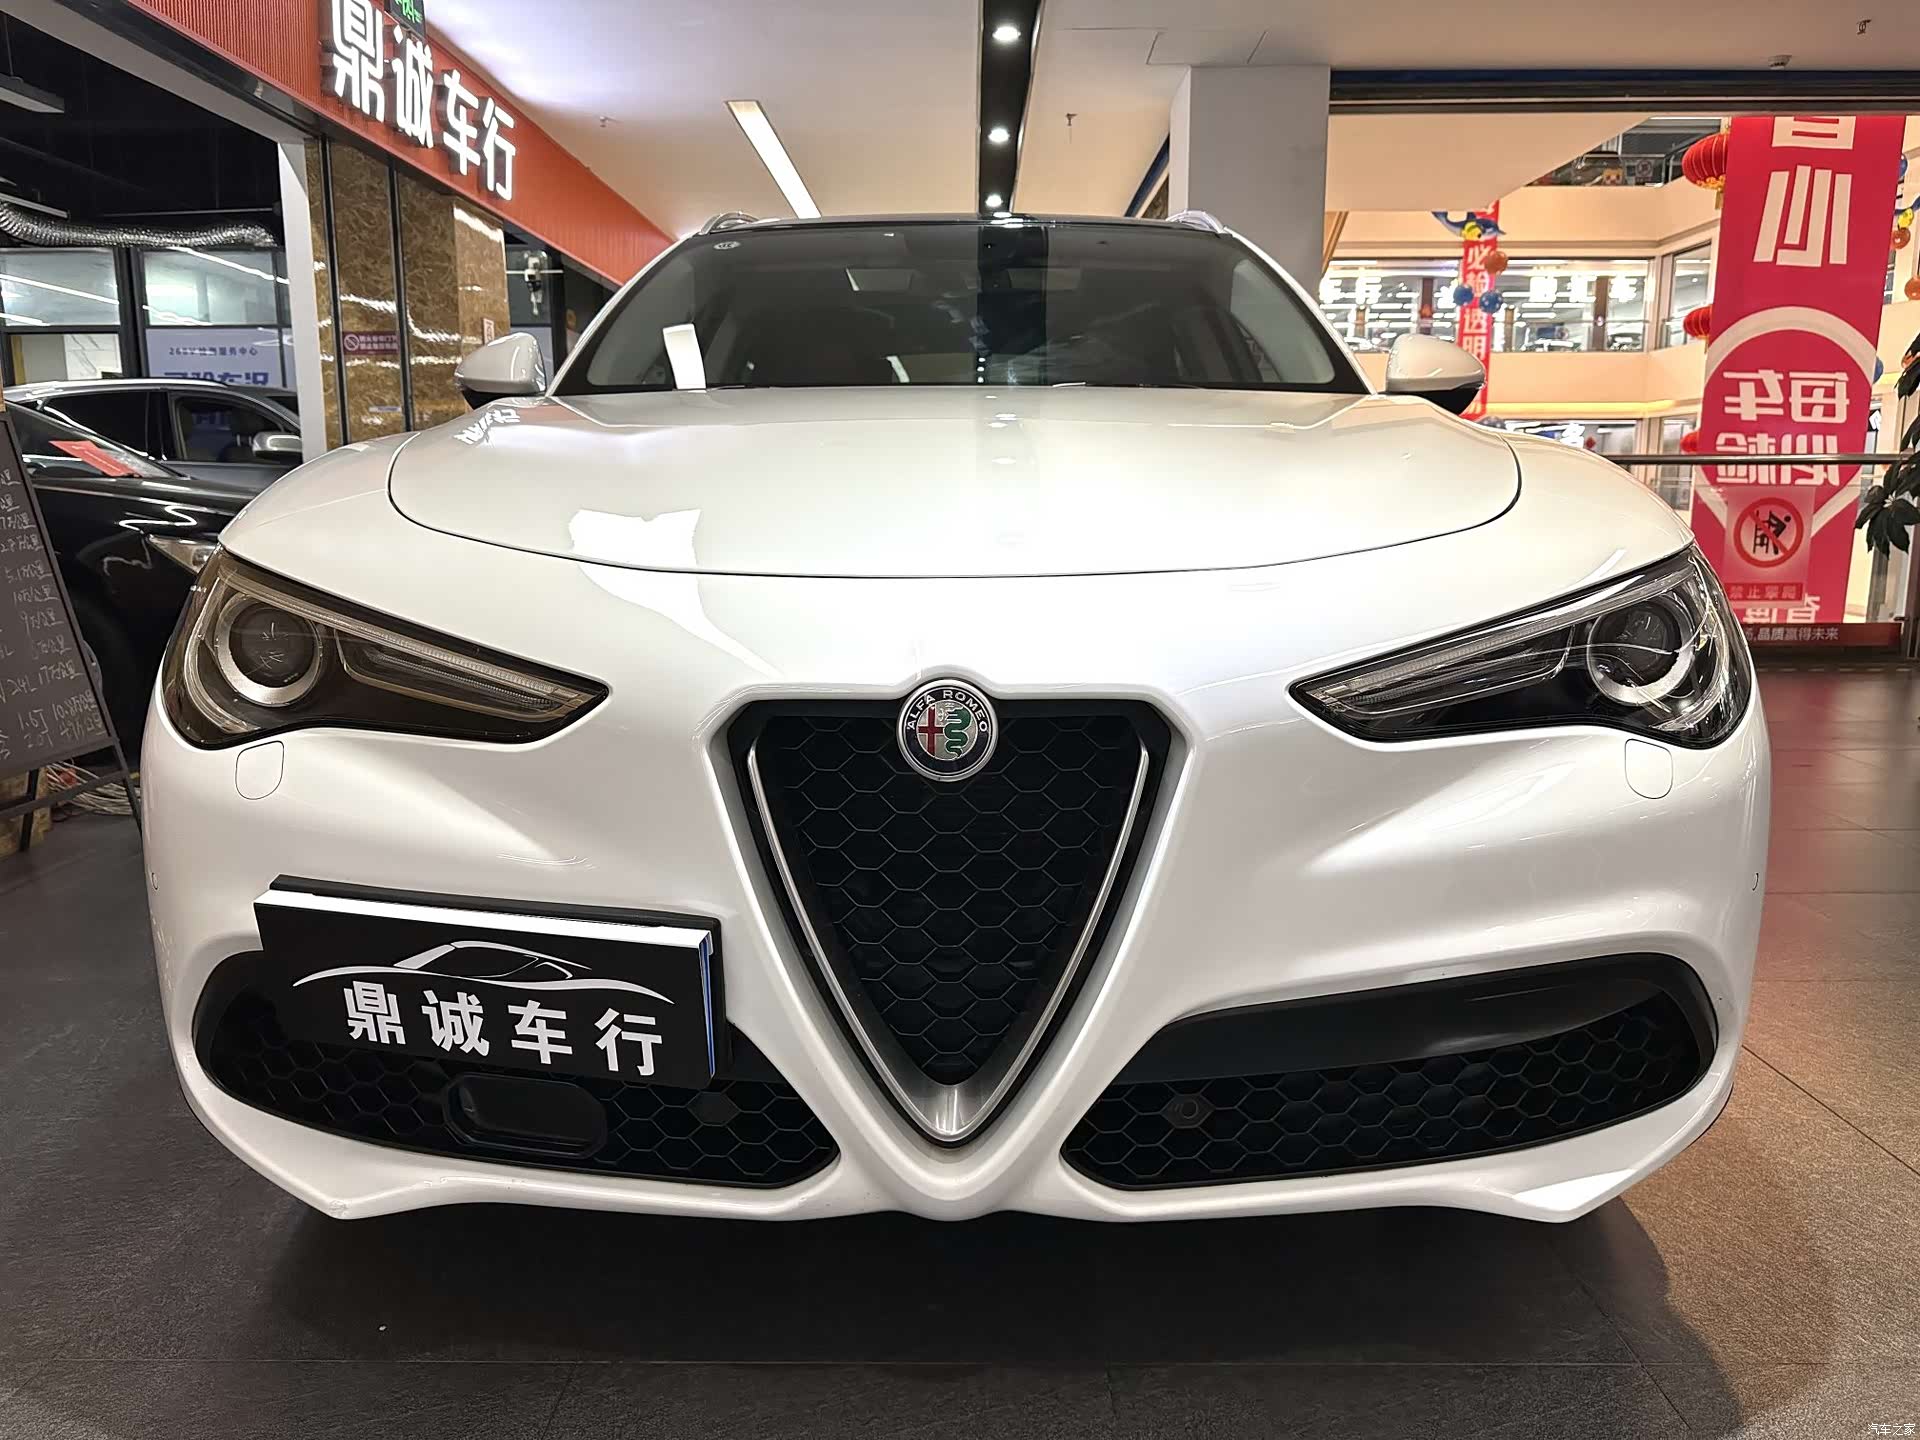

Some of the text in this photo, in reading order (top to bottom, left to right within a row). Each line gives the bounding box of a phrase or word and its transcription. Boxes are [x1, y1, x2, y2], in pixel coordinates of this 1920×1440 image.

[332, 0, 516, 201] 鼎诚车行
[906, 689, 988, 732] ALFA ROMEO
[343, 980, 663, 1077] 鼎诚车行
